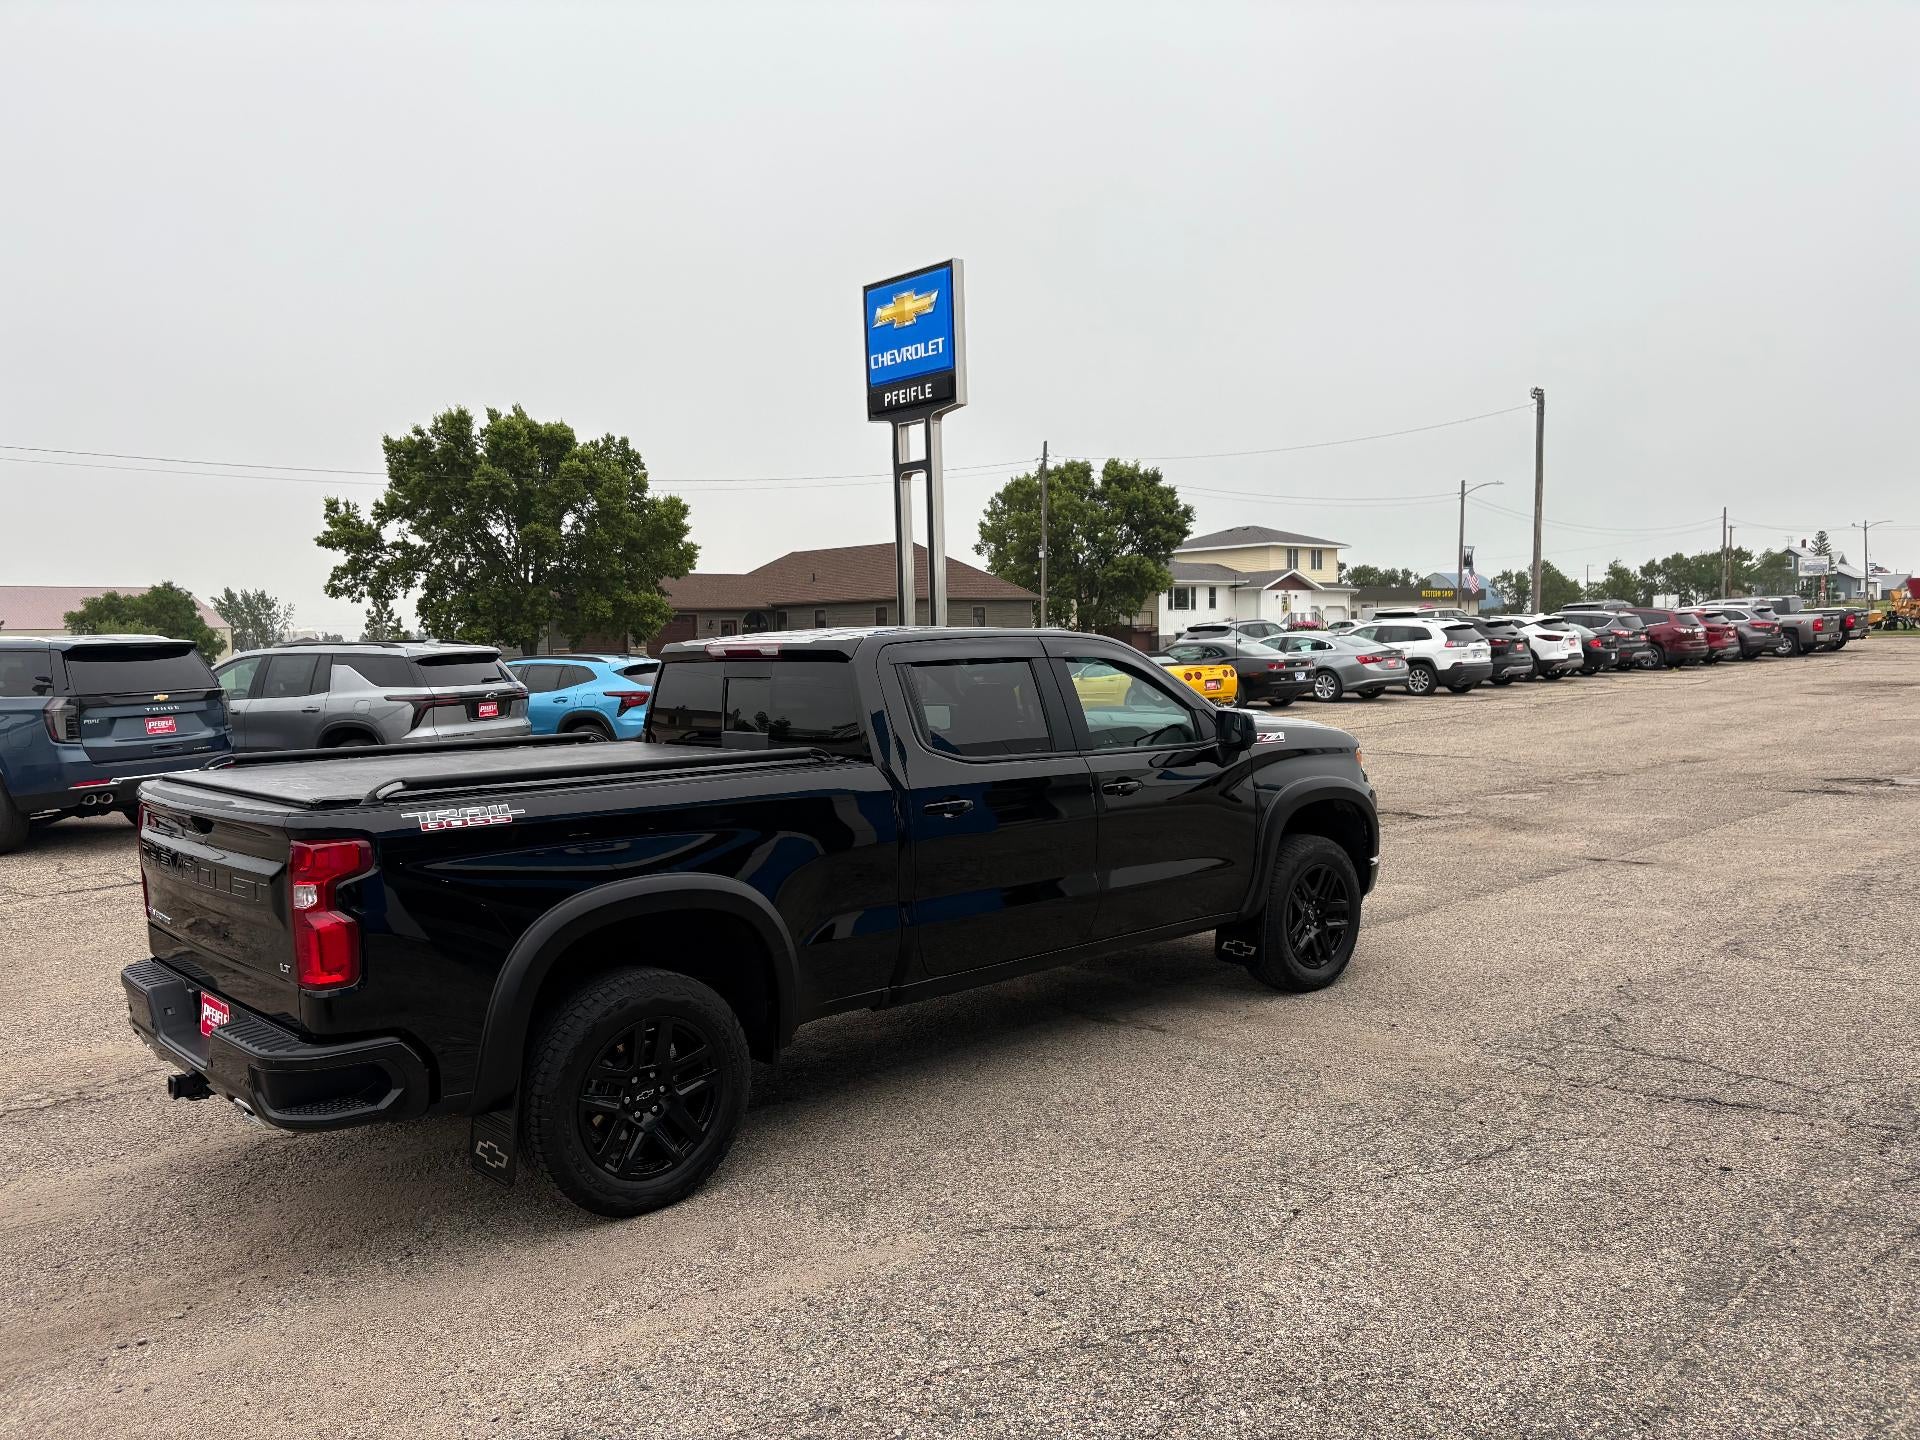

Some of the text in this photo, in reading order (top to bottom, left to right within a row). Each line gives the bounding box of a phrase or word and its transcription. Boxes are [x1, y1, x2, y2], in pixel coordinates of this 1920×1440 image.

[870, 337, 944, 369] CHEVROLET
[884, 383, 932, 406] PFEIFLE
[401, 804, 526, 823] TRAIL
[420, 814, 513, 831] BOSS
[279, 962, 291, 974] LT
